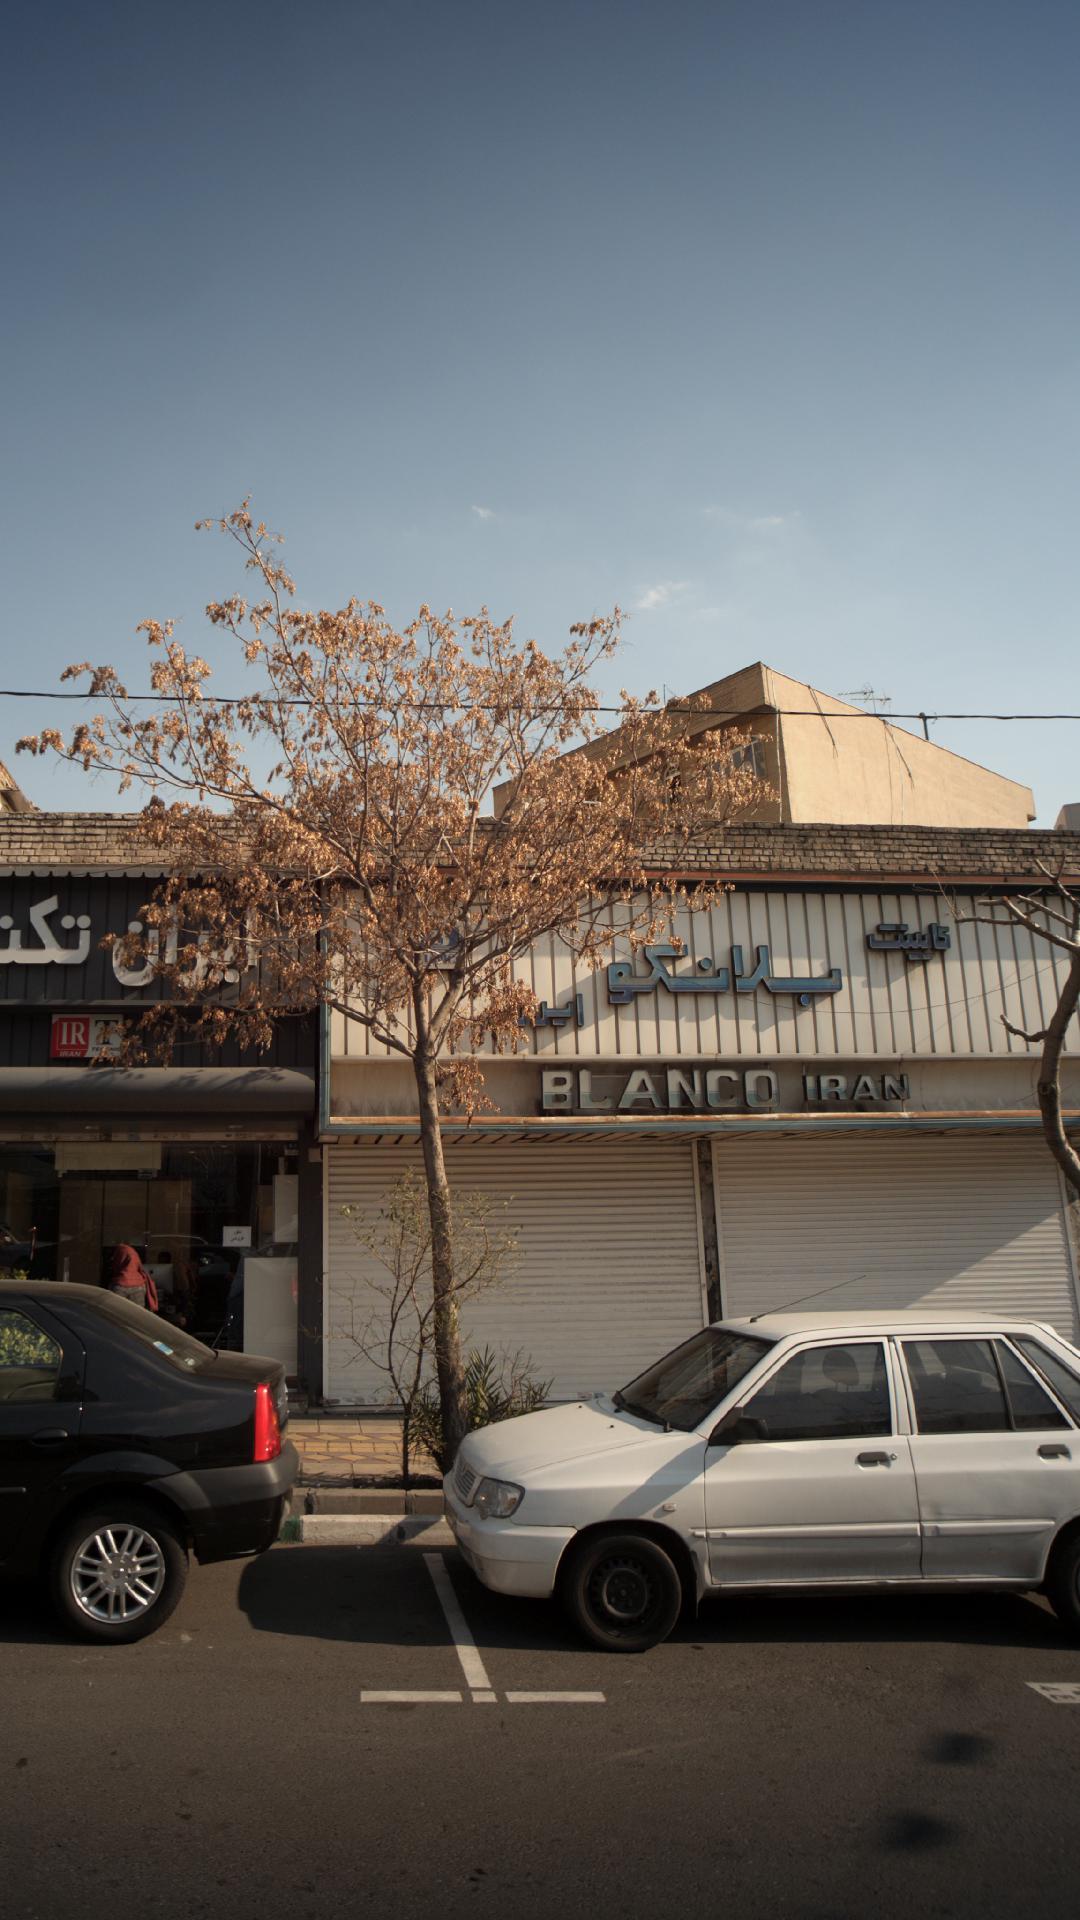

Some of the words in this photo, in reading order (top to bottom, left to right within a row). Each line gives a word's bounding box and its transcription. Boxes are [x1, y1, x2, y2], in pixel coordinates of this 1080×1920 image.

[0, 894, 91, 964] تکن
[608, 945, 843, 1005] بلانکو
[61, 1021, 86, 1046] IR
[541, 1069, 780, 1110] BLANCO
[803, 1073, 911, 1101] IRAN
